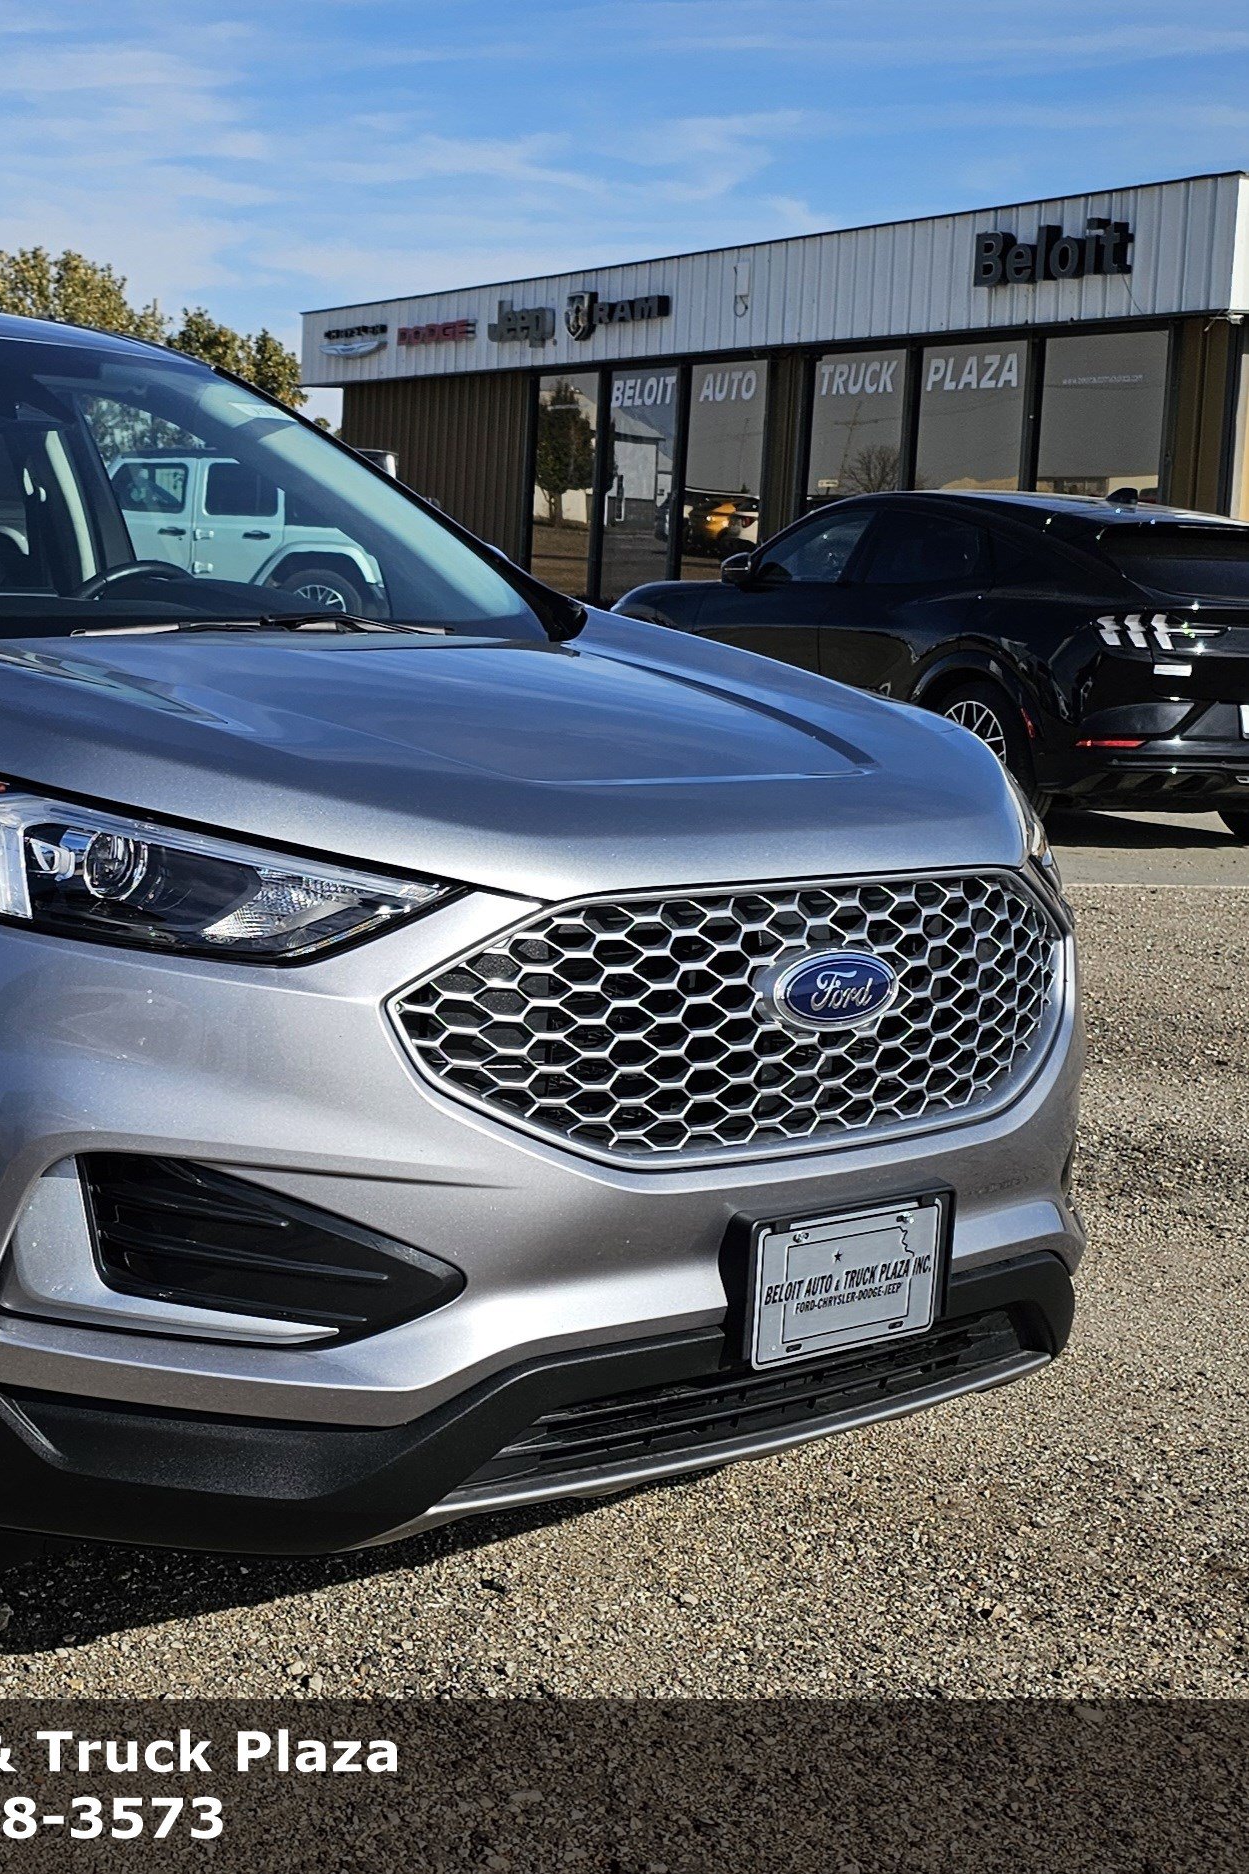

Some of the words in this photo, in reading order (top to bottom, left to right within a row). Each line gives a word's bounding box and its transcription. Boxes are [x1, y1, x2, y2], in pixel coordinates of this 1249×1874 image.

[973, 217, 1135, 287] Beloit
[397, 319, 478, 345] DODGE
[488, 300, 556, 348] Jeep
[593, 295, 670, 324] RAM
[611, 375, 677, 407] BELOIT
[700, 370, 757, 402] AUTO
[820, 360, 899, 396] TRUCK
[926, 353, 1018, 392] PLAZA
[810, 970, 873, 1012] Ford
[764, 1280, 805, 1306] BELOIT
[803, 1274, 833, 1298] AUTO
[843, 1265, 879, 1290] TRUCK
[878, 1259, 910, 1283] PLAZA
[912, 1254, 932, 1276] INC.
